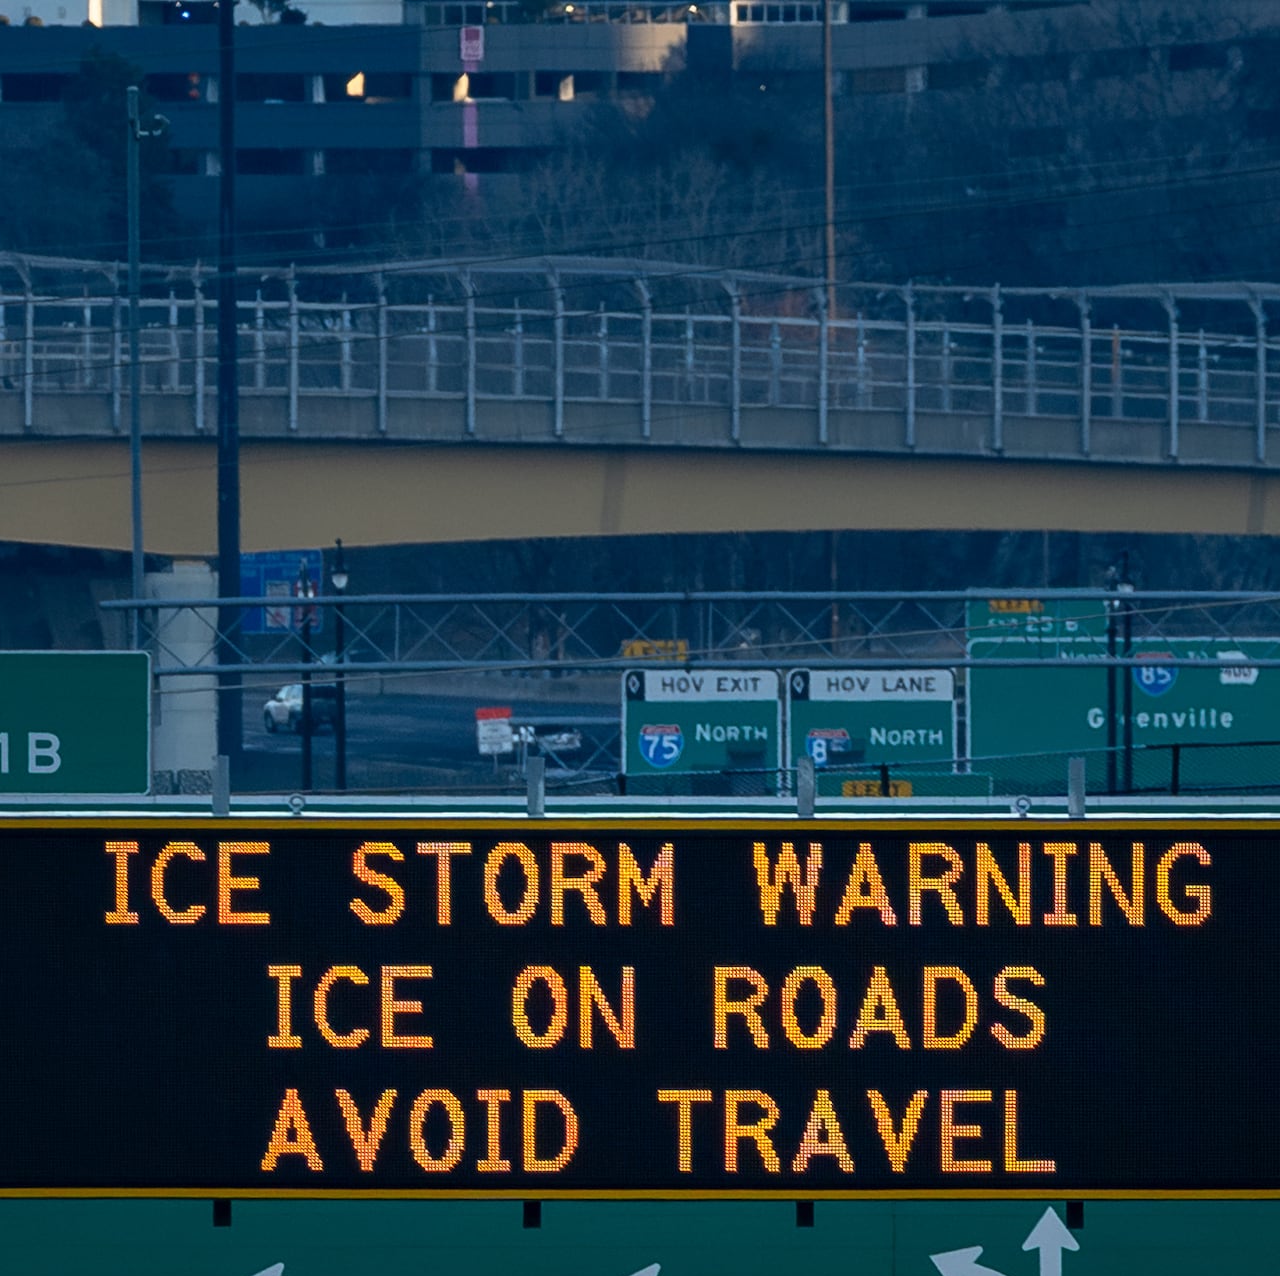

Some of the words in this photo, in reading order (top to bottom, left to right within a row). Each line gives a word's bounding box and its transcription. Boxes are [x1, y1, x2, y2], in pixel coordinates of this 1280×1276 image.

[662, 677, 704, 693] HOV
[717, 677, 761, 693] EXIT
[827, 676, 871, 693] HOV
[882, 676, 937, 693] LANE
[1087, 706, 1233, 729] Genville
[695, 724, 769, 742] NORTH
[870, 727, 944, 746] NORTH
[643, 735, 679, 760] 75
[106, 842, 270, 924] ICE
[350, 842, 674, 925] STORM
[753, 843, 1211, 926] WARNING
[268, 965, 433, 1048] ICE
[513, 966, 635, 1048] ON
[714, 966, 1045, 1049] ROADS
[261, 1089, 578, 1172] AVOID
[658, 1090, 1055, 1172] TRAVEL
